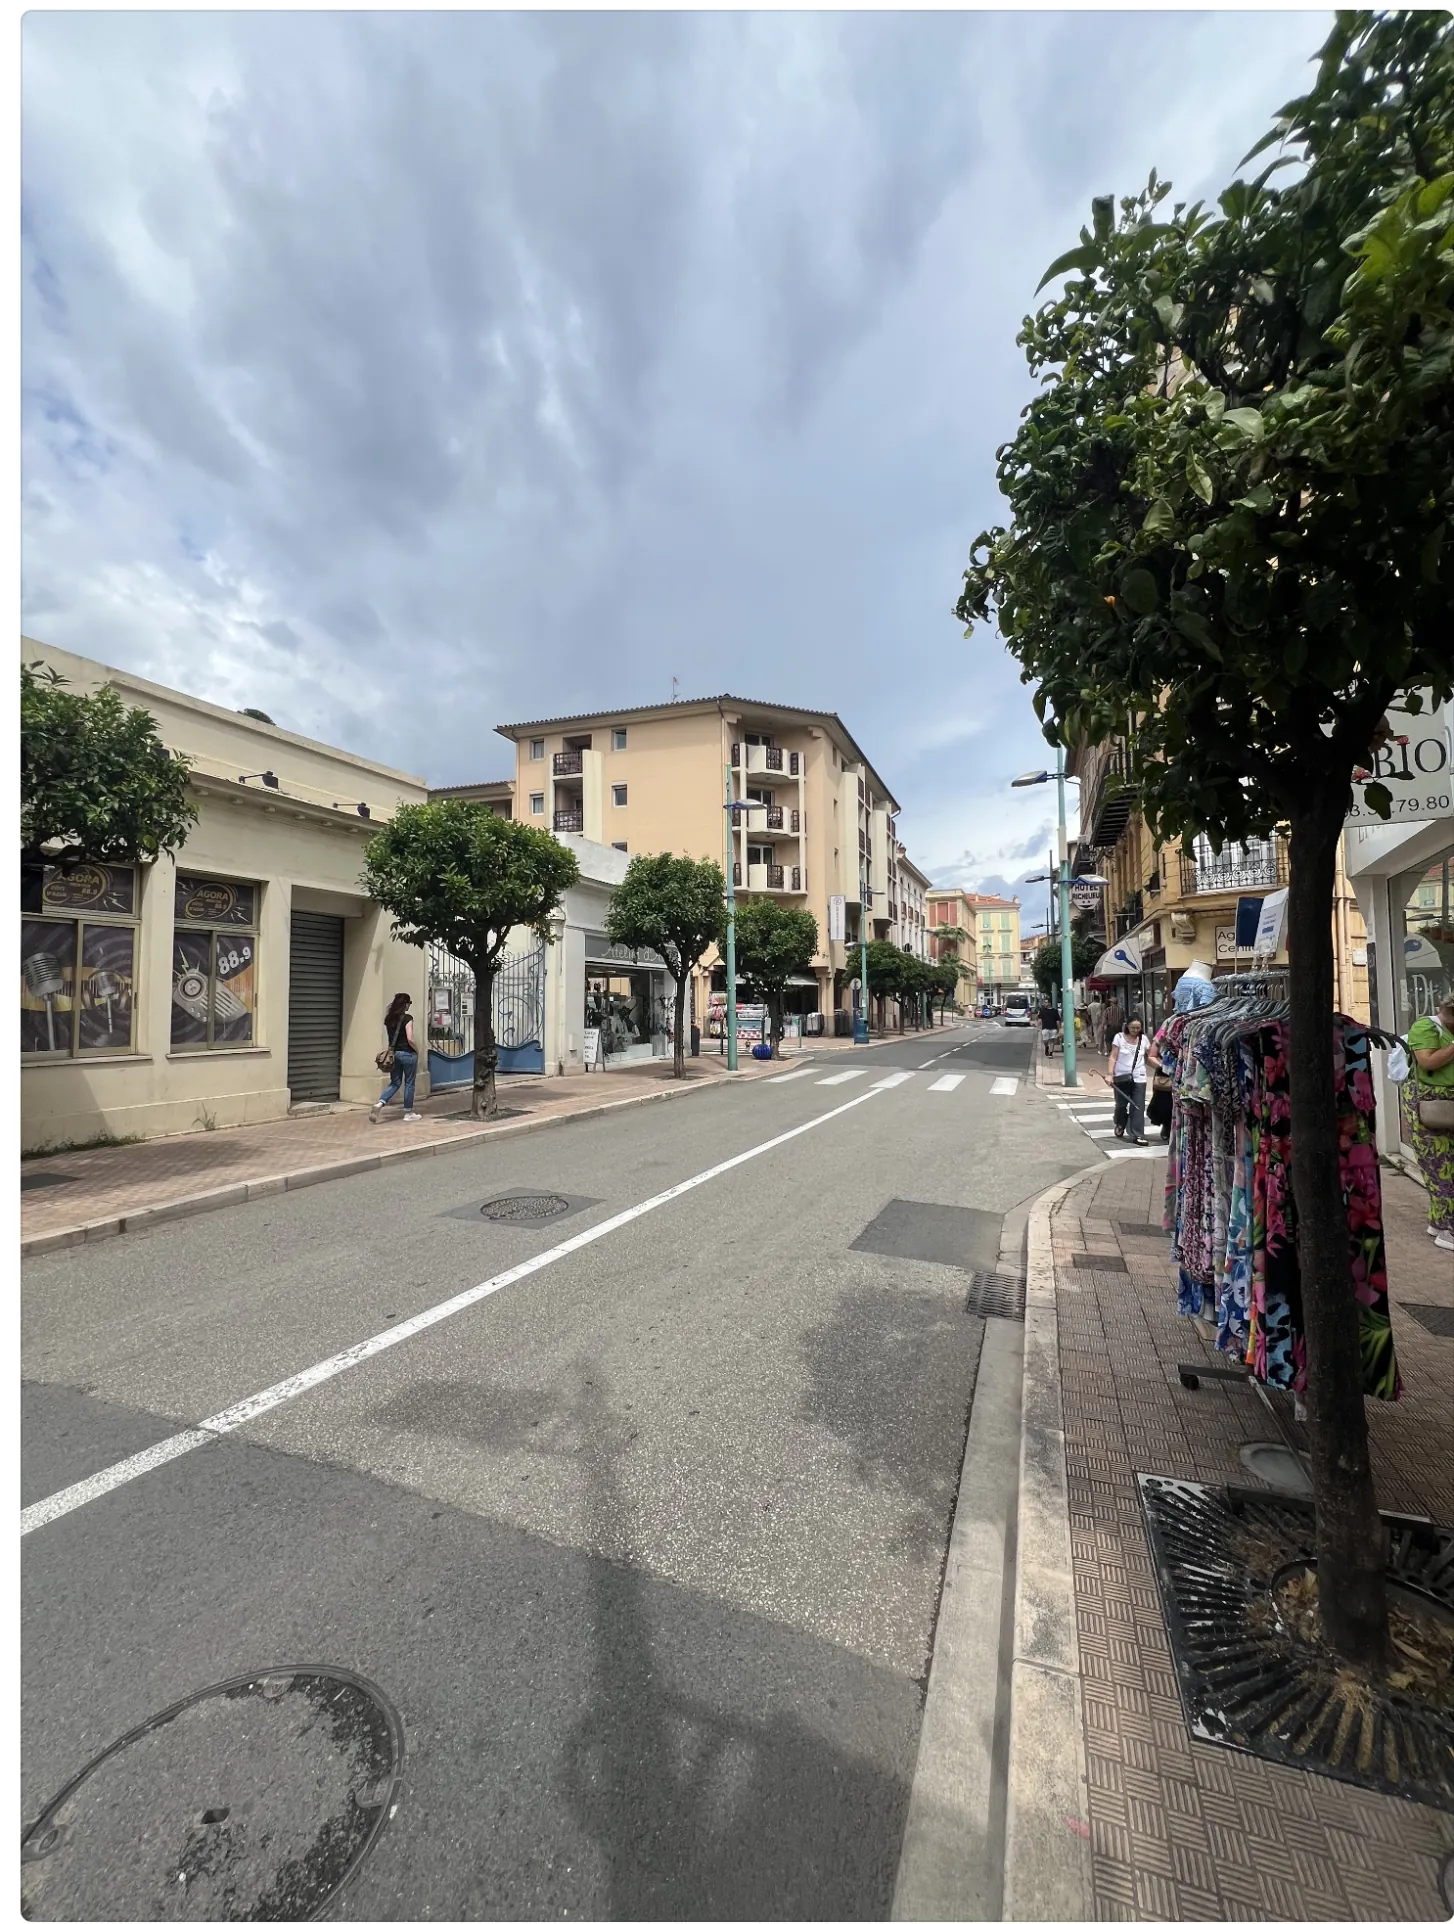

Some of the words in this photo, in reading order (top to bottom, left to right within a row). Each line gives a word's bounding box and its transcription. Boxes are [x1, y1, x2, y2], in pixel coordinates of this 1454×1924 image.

[1372, 738, 1447, 778] BIO
[57, 871, 99, 884] AGORA
[197, 889, 228, 900] AGORA
[1072, 892, 1101, 900] RICHELIEU
[218, 946, 252, 975] 88.9
